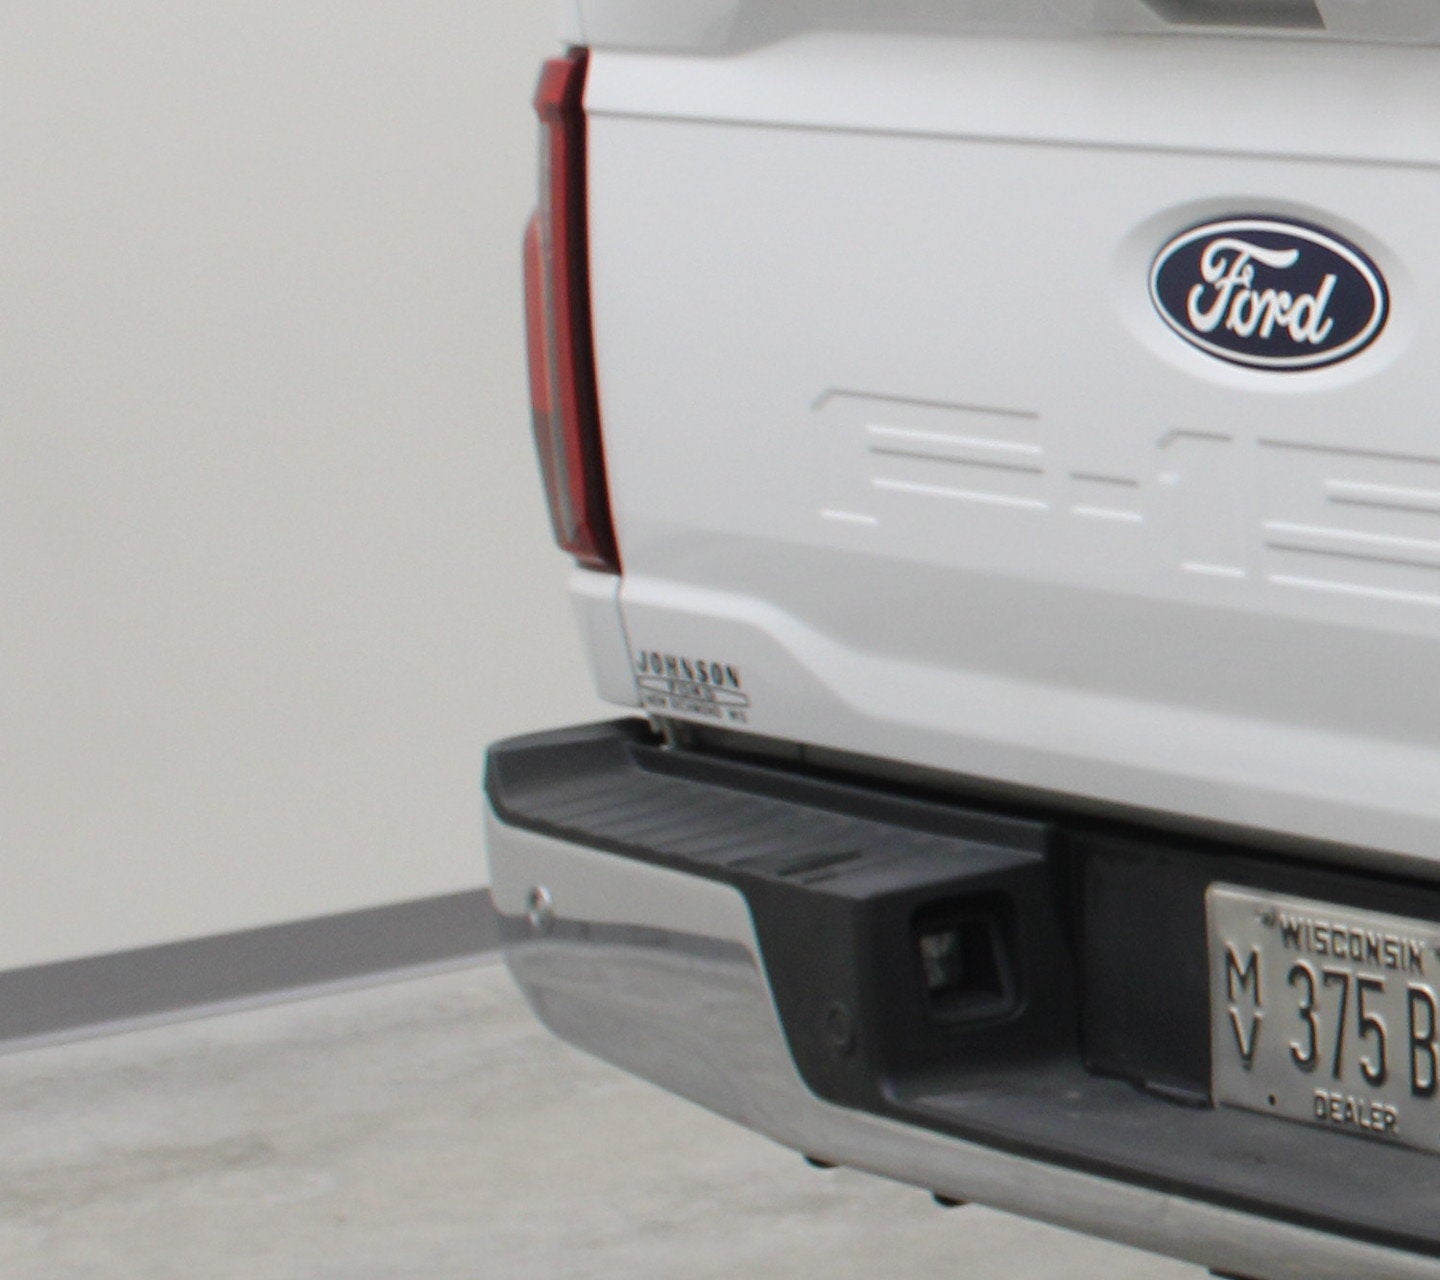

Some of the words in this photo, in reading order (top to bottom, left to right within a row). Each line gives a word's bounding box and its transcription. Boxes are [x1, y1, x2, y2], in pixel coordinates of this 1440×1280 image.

[1185, 236, 1338, 346] Ford
[639, 650, 742, 689] JOHNSON
[1279, 913, 1426, 974] WISCONSIN
[1287, 958, 1389, 1089] 375
[1313, 1086, 1399, 1133] DEALER
